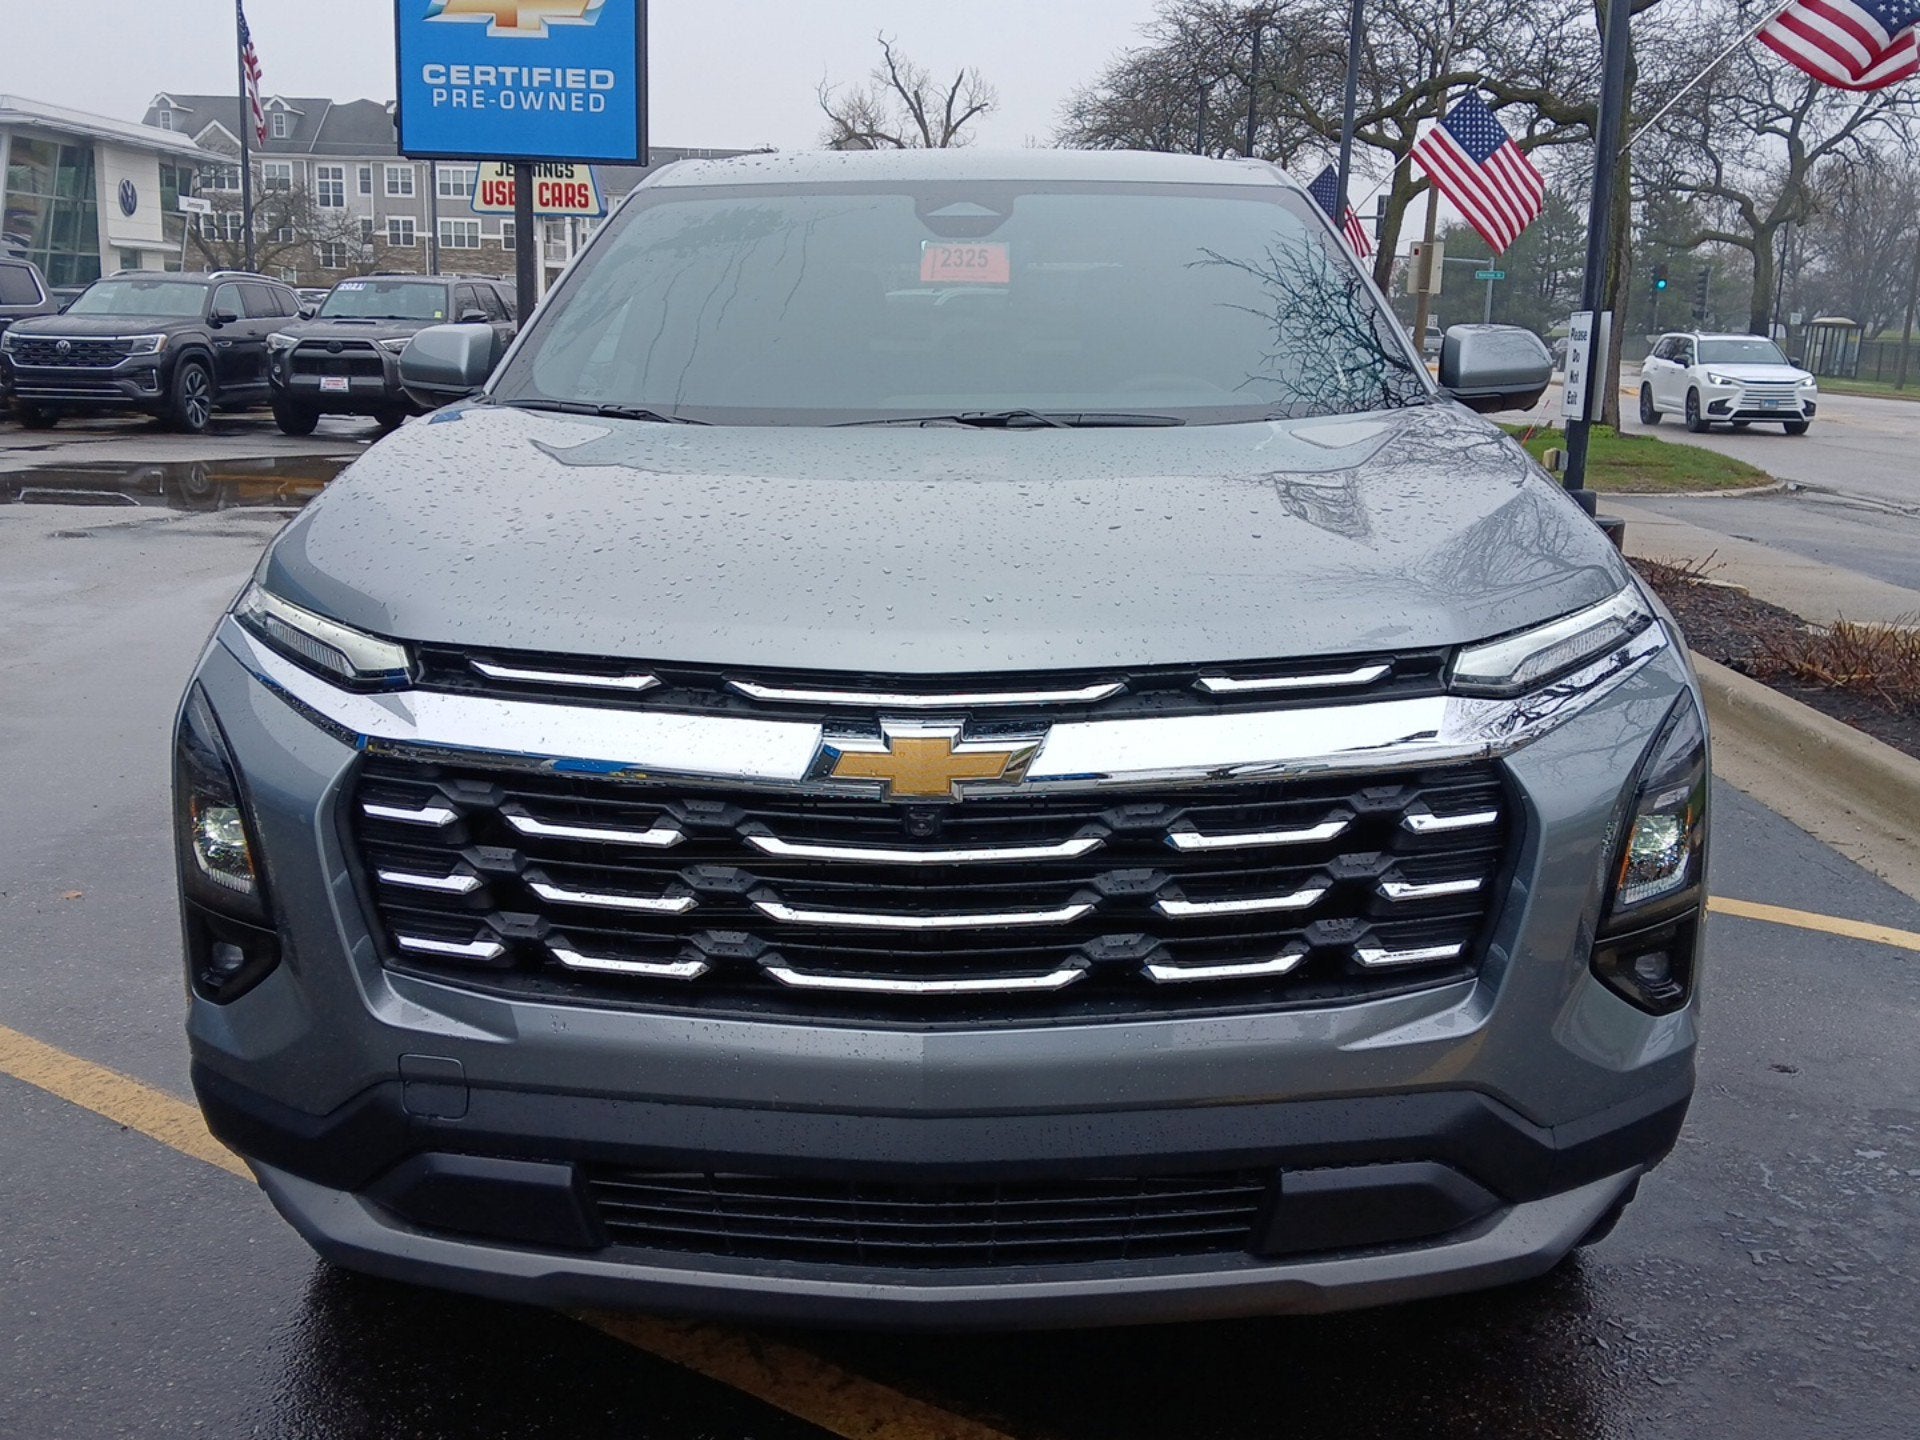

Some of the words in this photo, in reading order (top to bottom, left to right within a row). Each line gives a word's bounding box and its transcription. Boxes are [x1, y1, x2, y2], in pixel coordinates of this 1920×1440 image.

[422, 63, 615, 90] CERTIFIED
[432, 87, 606, 113] PRE-OWNED
[495, 161, 574, 179] JEINGS
[482, 180, 516, 206] USE
[538, 182, 589, 208] CARS
[940, 247, 989, 269] 2325
[1570, 327, 1588, 341] Please
[1572, 348, 1581, 363] Do
